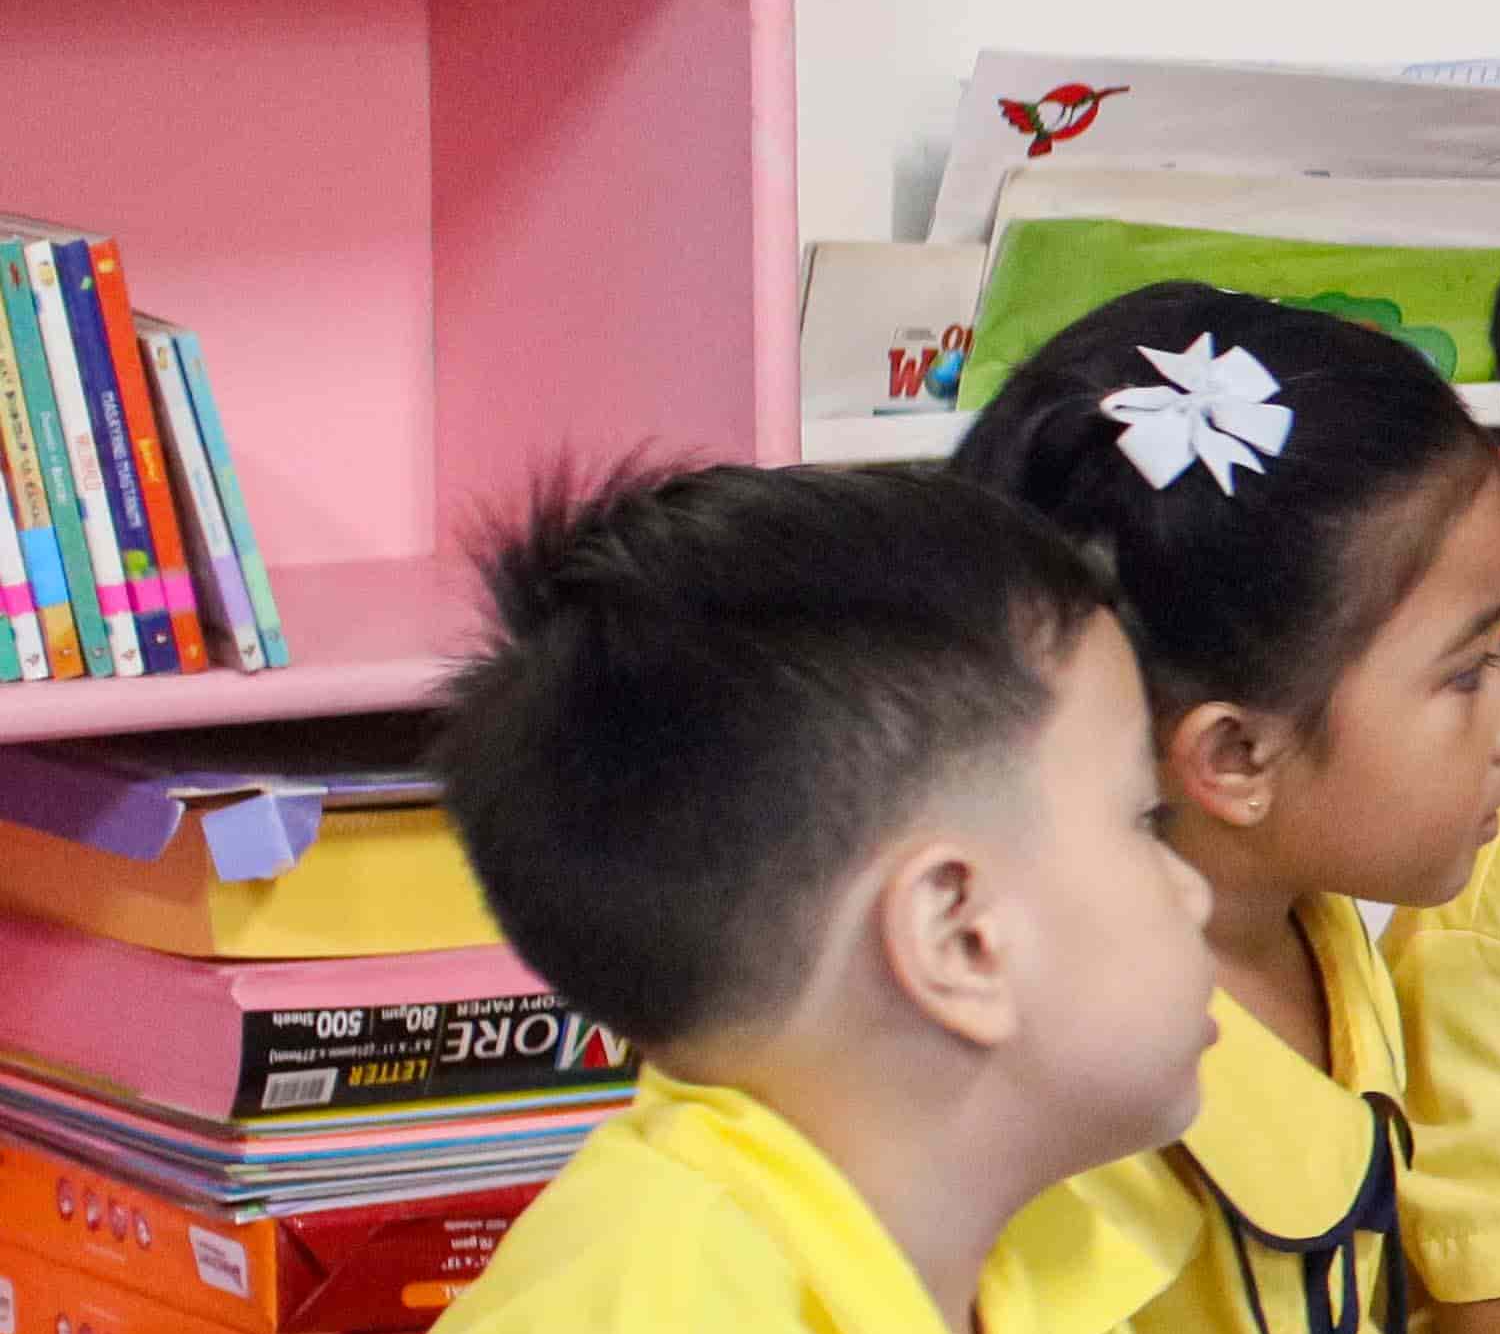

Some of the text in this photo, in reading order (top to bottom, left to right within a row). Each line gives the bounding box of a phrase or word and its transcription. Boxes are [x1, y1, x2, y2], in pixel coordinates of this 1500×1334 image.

[457, 993, 566, 1016] OPY PAPER
[317, 1010, 362, 1039] 500
[441, 1012, 628, 1070] MORE
[348, 1059, 428, 1086] LETTER
